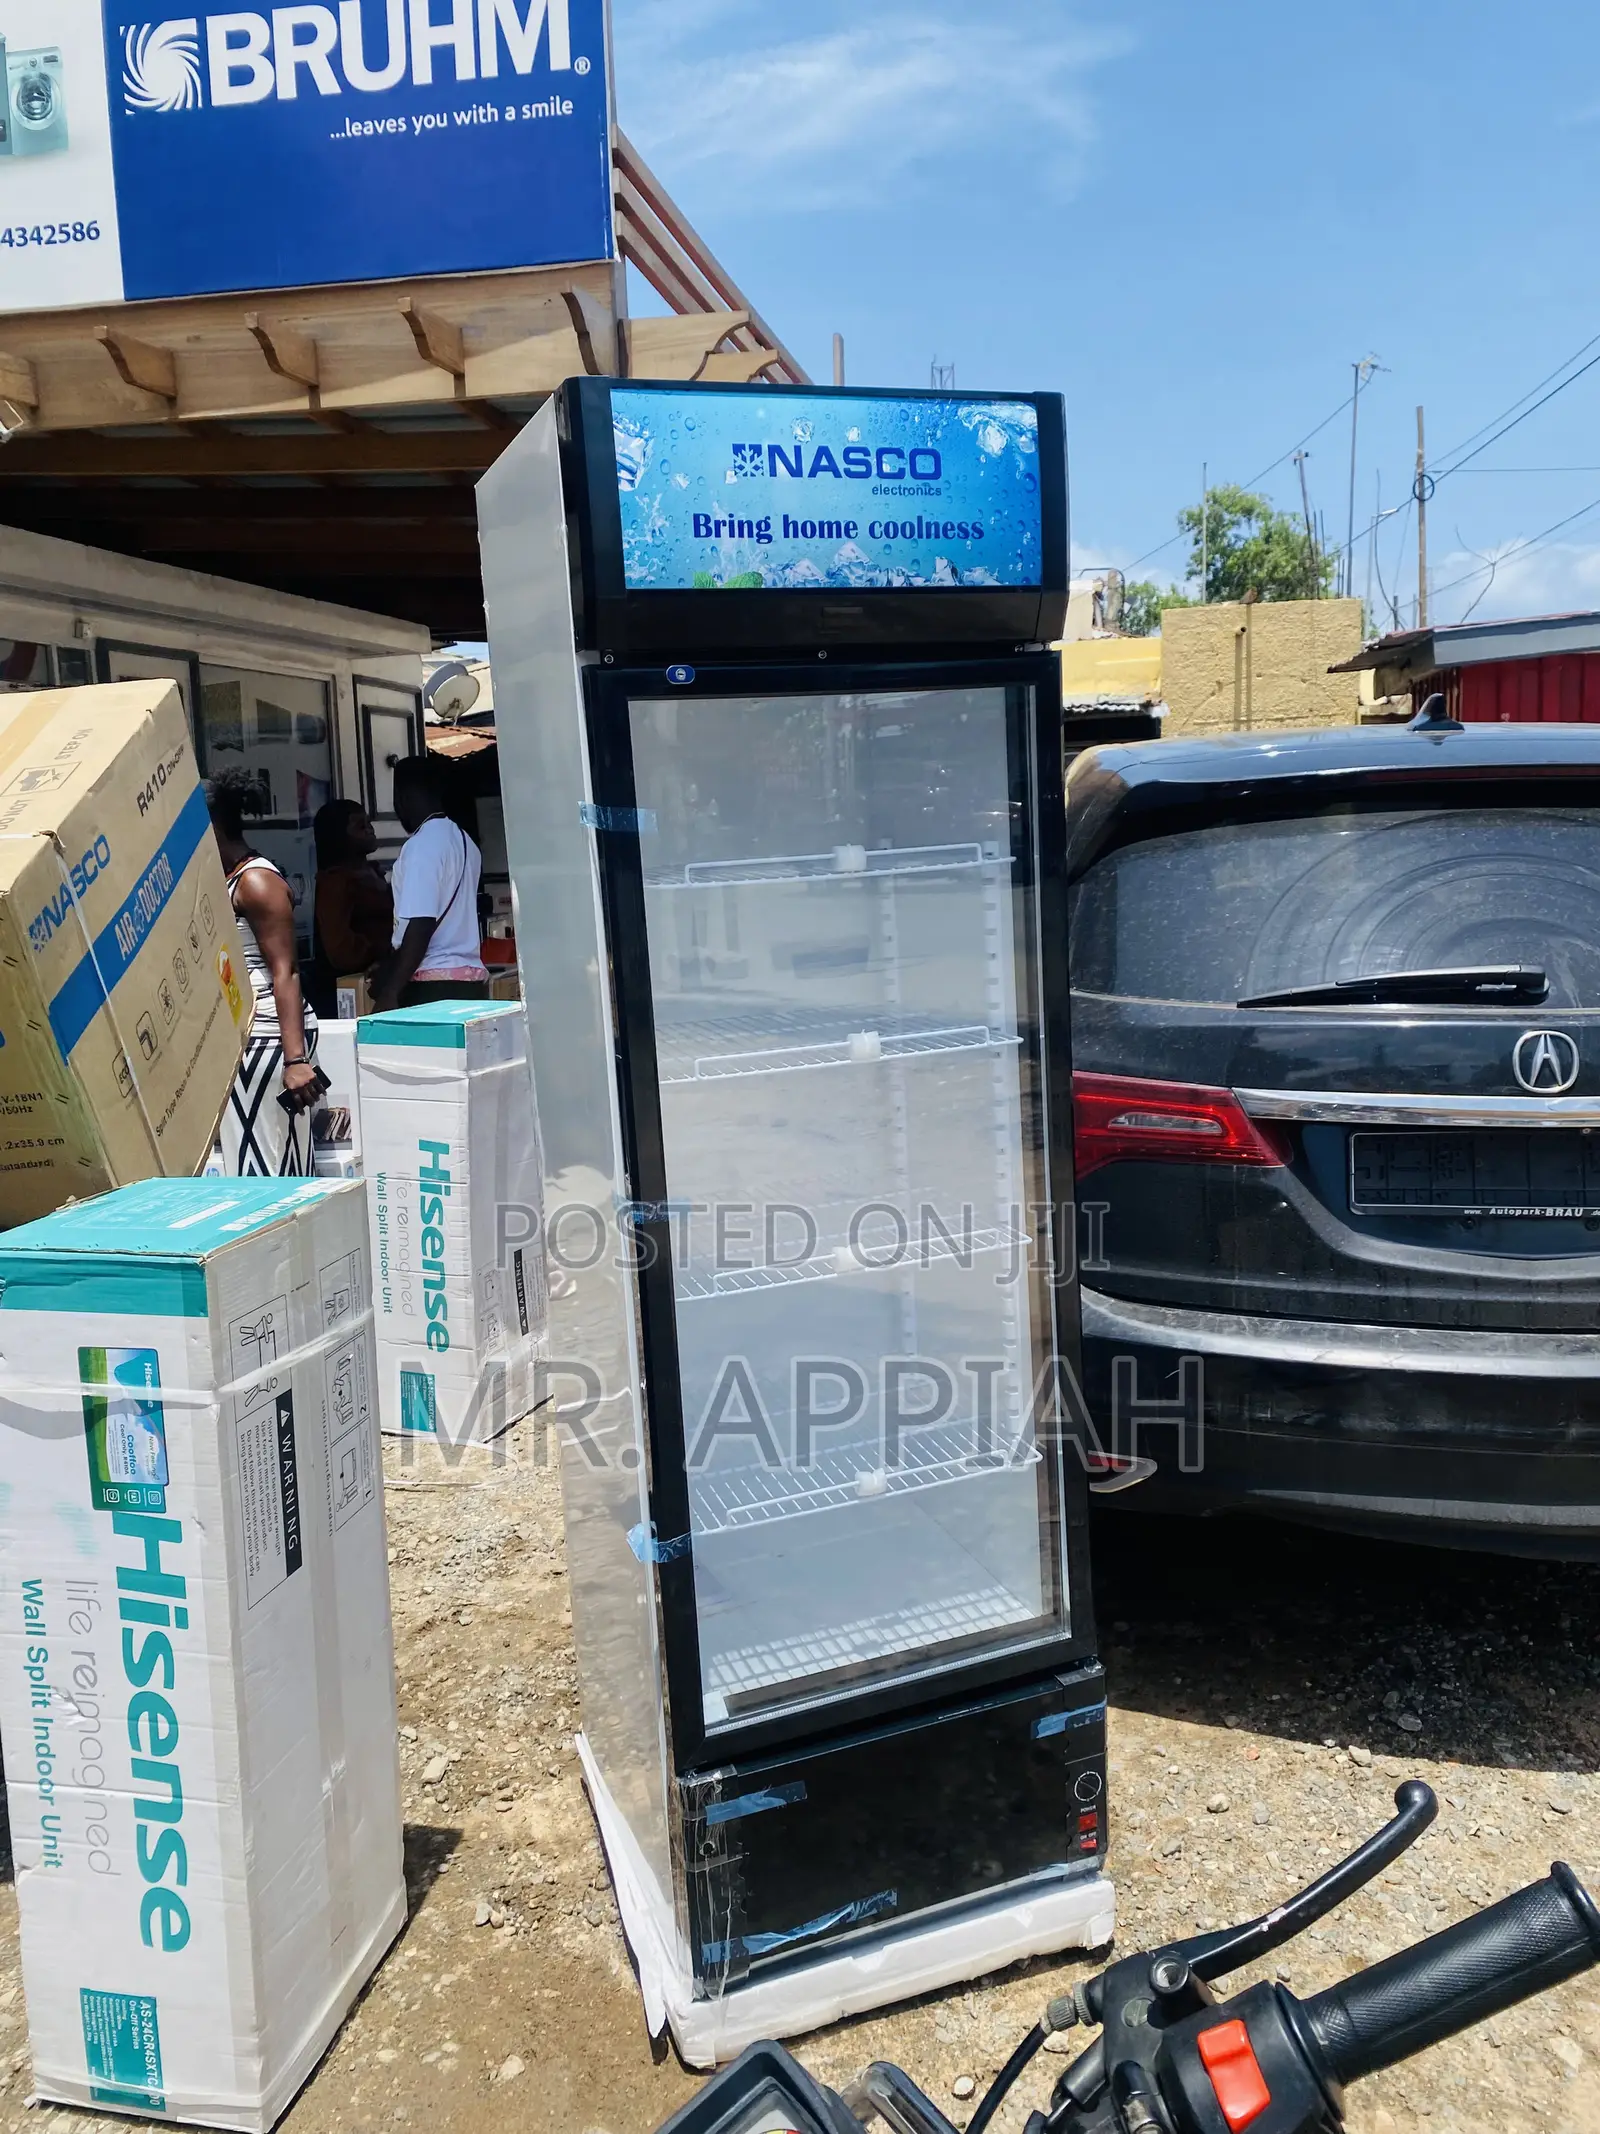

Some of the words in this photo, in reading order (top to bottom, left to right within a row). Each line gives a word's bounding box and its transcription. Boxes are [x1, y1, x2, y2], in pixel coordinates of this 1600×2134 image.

[206, 0, 571, 107] BRUHM
[330, 116, 407, 139] ...leaves
[412, 111, 448, 136] you
[453, 102, 499, 125] with
[505, 106, 516, 121] a
[522, 96, 573, 119] smile
[0, 219, 100, 249] 4342586
[768, 444, 942, 480] NASCO
[871, 484, 942, 497] electronics
[692, 513, 773, 544] Bring
[782, 514, 858, 539] home
[868, 515, 985, 539] coolness
[4, 799, 33, 819] NOT
[54, 742, 82, 761] STEP
[136, 763, 167, 817] R410
[42, 834, 111, 939] NASCO
[114, 911, 139, 961] AIR
[138, 852, 174, 922] DOCTOR
[0, 1105, 33, 1115] /50Hz
[165, 1099, 177, 1118] Type
[48, 1138, 65, 1146] cm
[376, 1172, 386, 1199] Wall
[1489, 1207, 1583, 1217] Autopark-BRAU
[376, 1204, 389, 1235] Split
[419, 1139, 451, 1353] Hisense
[379, 1238, 389, 1284] Indoor
[396, 1206, 417, 1317] reimagined
[515, 1261, 525, 1315] WARNING
[382, 1288, 392, 1313] Unit
[144, 1362, 154, 1408] Hisee
[282, 1433, 298, 1550] WARNING
[251, 1508, 259, 1555] instruction
[22, 1579, 47, 1637] Wall
[66, 1579, 102, 1636] life
[27, 1646, 51, 1707] Split
[34, 1715, 55, 1801] Indoor
[112, 1511, 191, 1953] Hisense
[71, 1648, 121, 1876] reimagined
[39, 1815, 63, 1869] Unit
[131, 2026, 139, 2050] Series
[140, 2000, 160, 2106] AS-24CR4SXTC00
